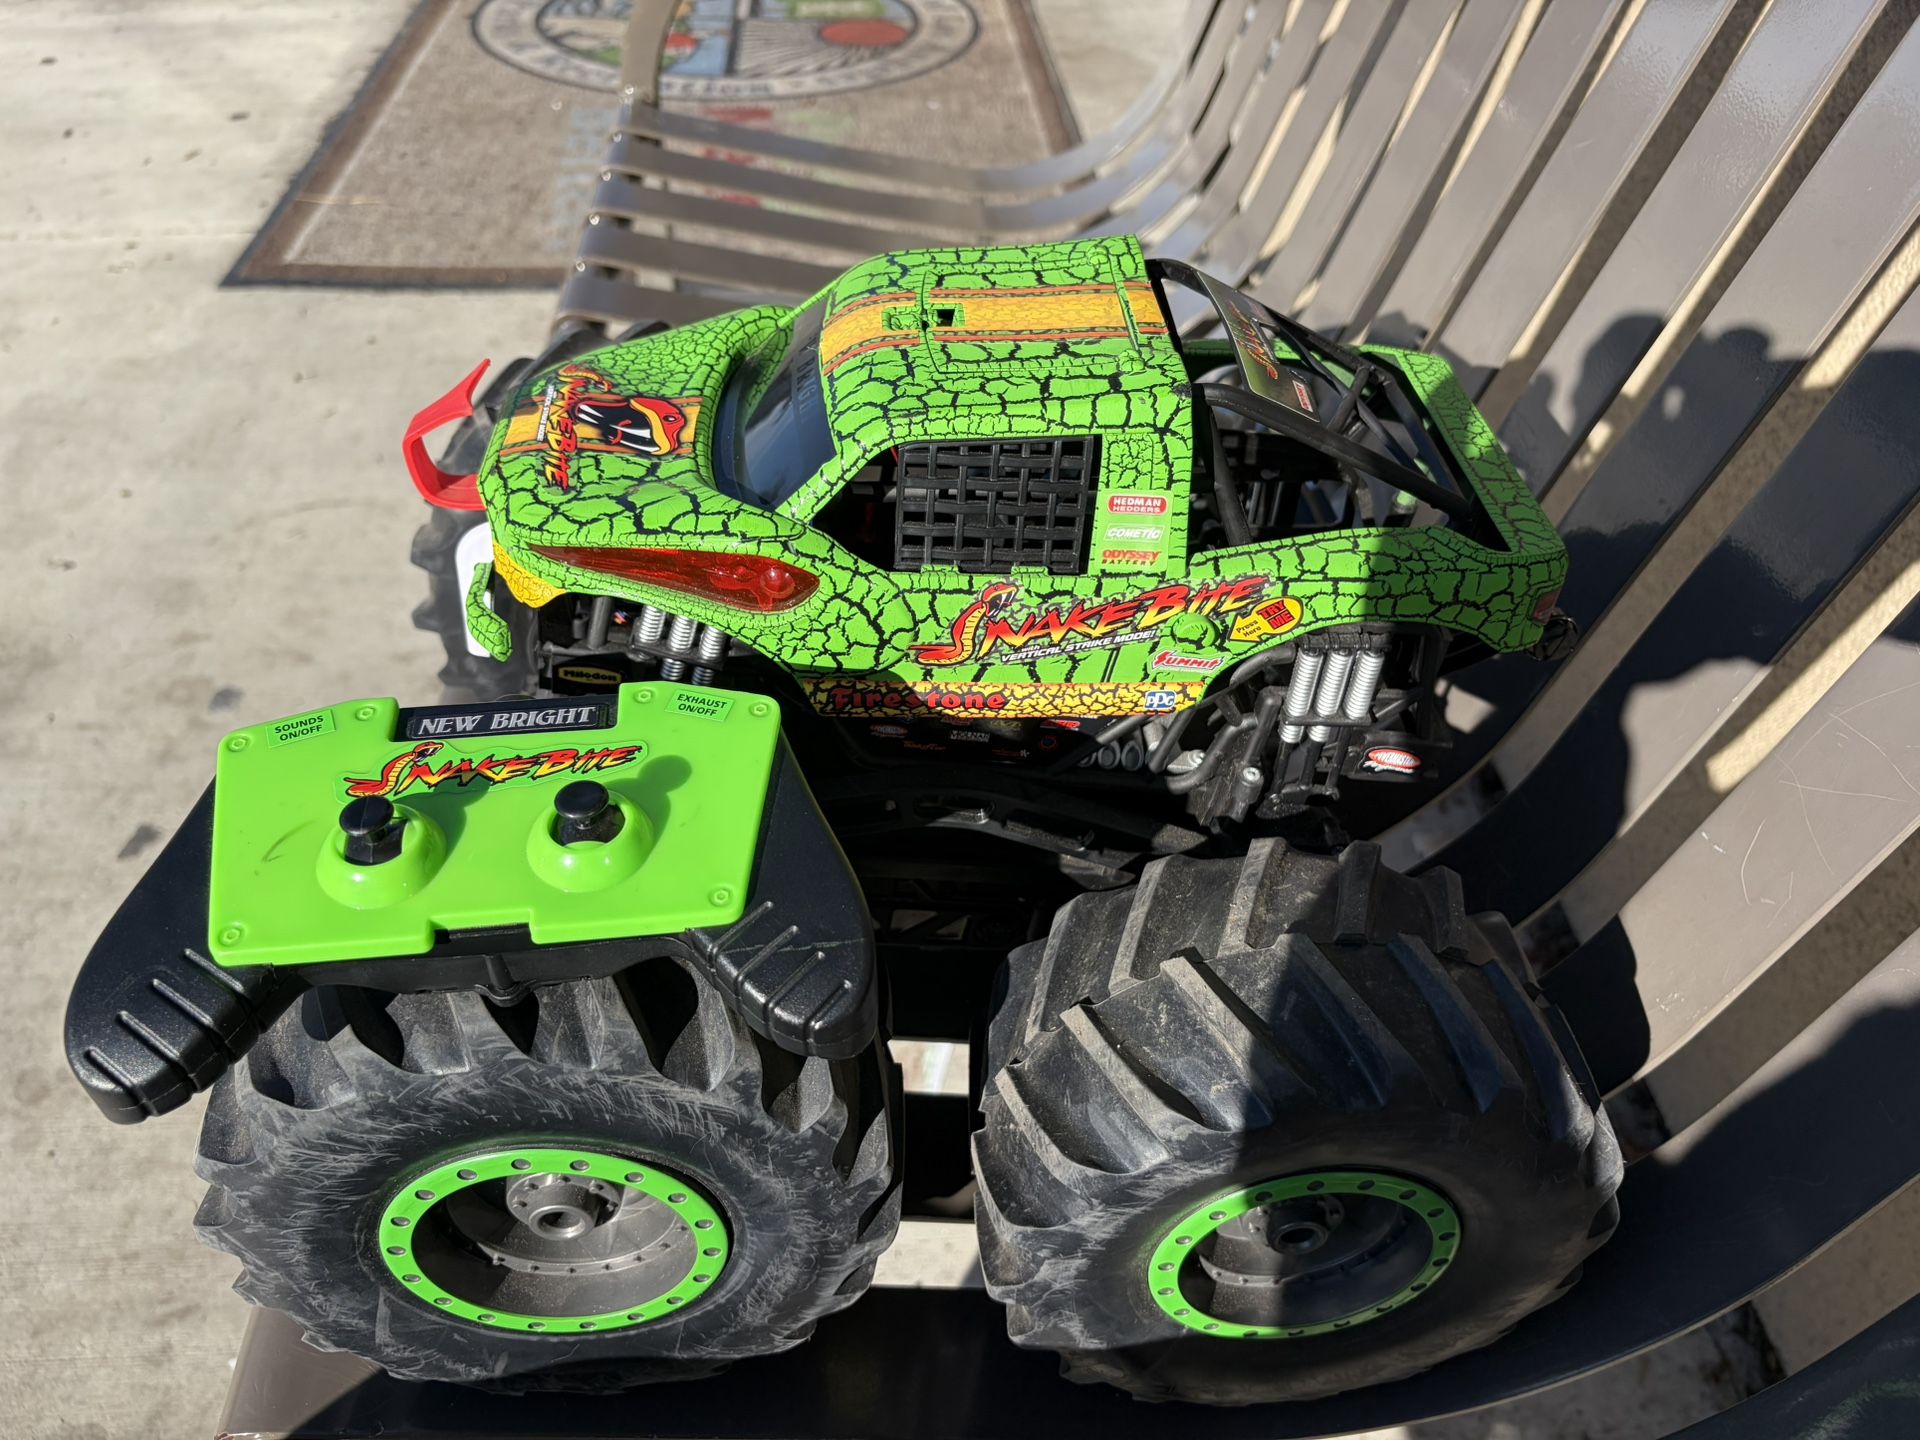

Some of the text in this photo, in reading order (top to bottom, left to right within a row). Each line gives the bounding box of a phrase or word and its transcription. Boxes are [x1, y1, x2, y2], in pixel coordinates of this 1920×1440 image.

[1112, 497, 1162, 507] HEDMAN
[1112, 505, 1161, 513] HEDDERS
[1107, 527, 1161, 539] COMETIC
[1102, 549, 1161, 560] ODYSSEY
[1256, 600, 1286, 620] TRY
[1236, 619, 1259, 634] Press
[1267, 610, 1295, 630] ME
[1242, 626, 1262, 638] Here
[1001, 630, 1157, 662] VERTICAL STRIKE MODE!
[1021, 644, 1041, 653] with
[1154, 651, 1220, 669] SUMMIT
[563, 668, 618, 682] Milodon
[676, 693, 727, 709] EXHAUST
[830, 687, 1006, 710] Firestone
[1145, 692, 1175, 708] PPG
[678, 703, 718, 717] ON/OFF
[274, 715, 324, 734] SOUNDS
[418, 706, 597, 735] NEW BRIGHT
[279, 724, 323, 742] ON/OFF
